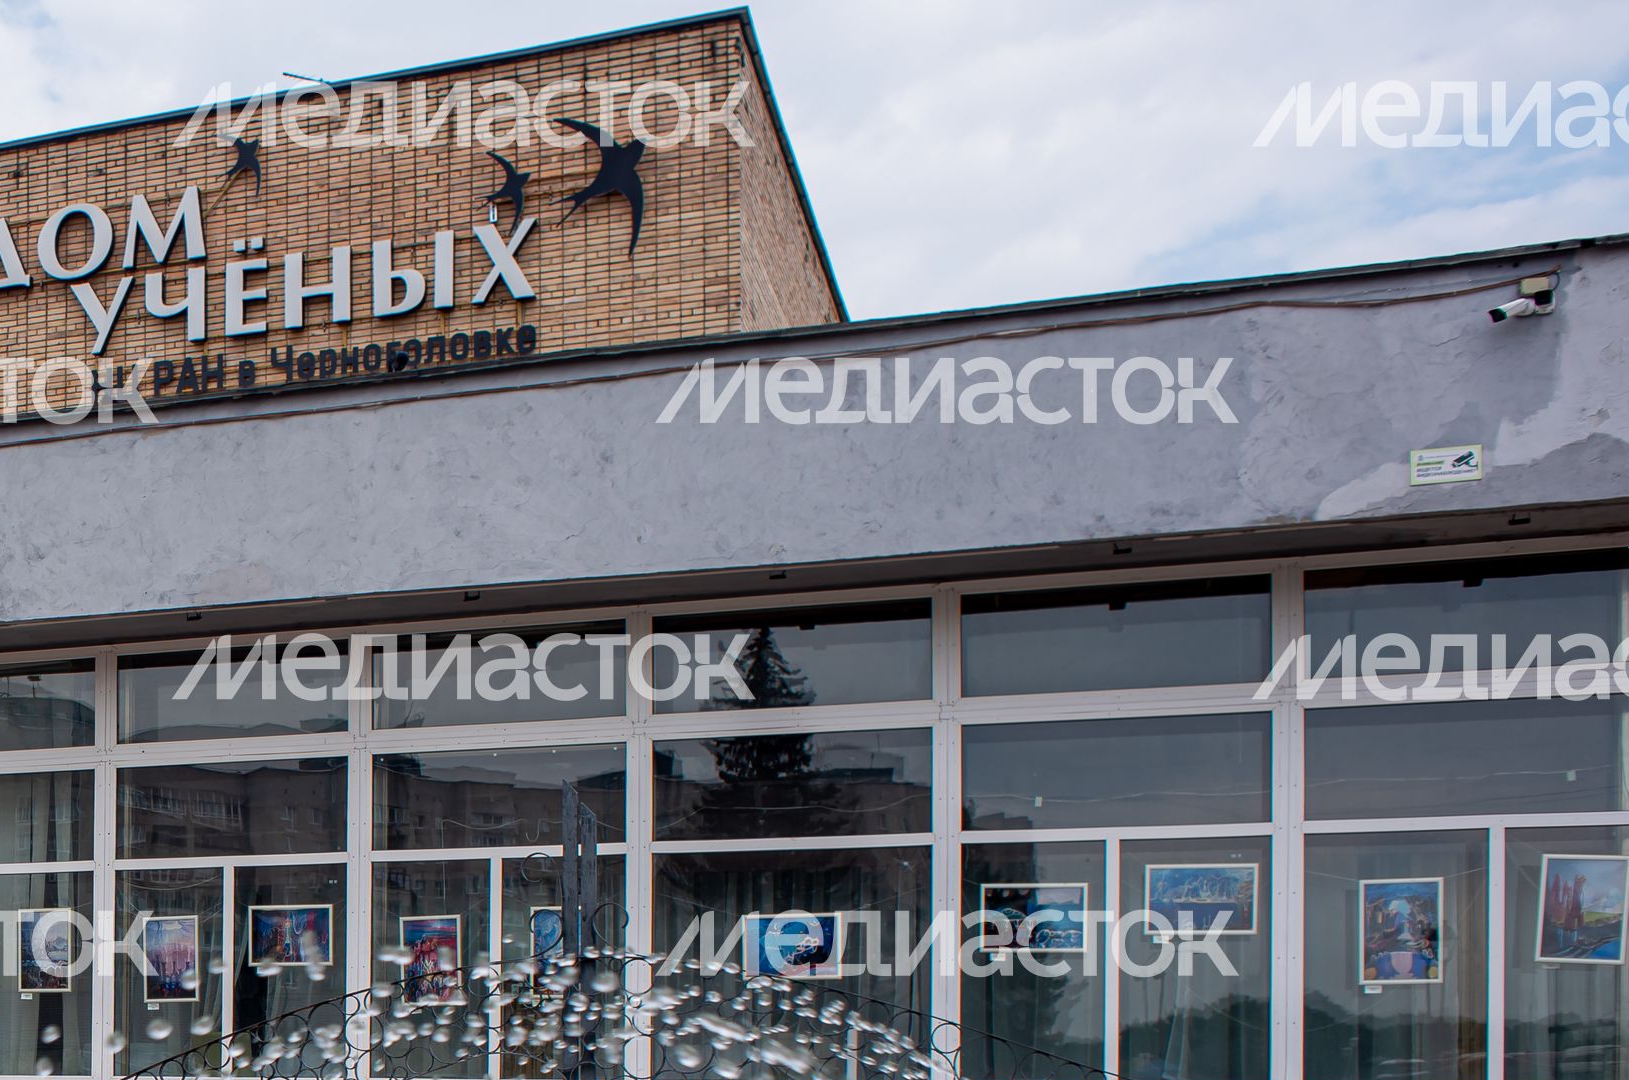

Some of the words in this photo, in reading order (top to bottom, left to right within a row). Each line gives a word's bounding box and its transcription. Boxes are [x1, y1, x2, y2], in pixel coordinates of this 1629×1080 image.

[70, 217, 539, 355] УЧЁНЫХ
[153, 353, 225, 396] РАН
[239, 359, 256, 388] в
[272, 325, 538, 384] Черноголовке
